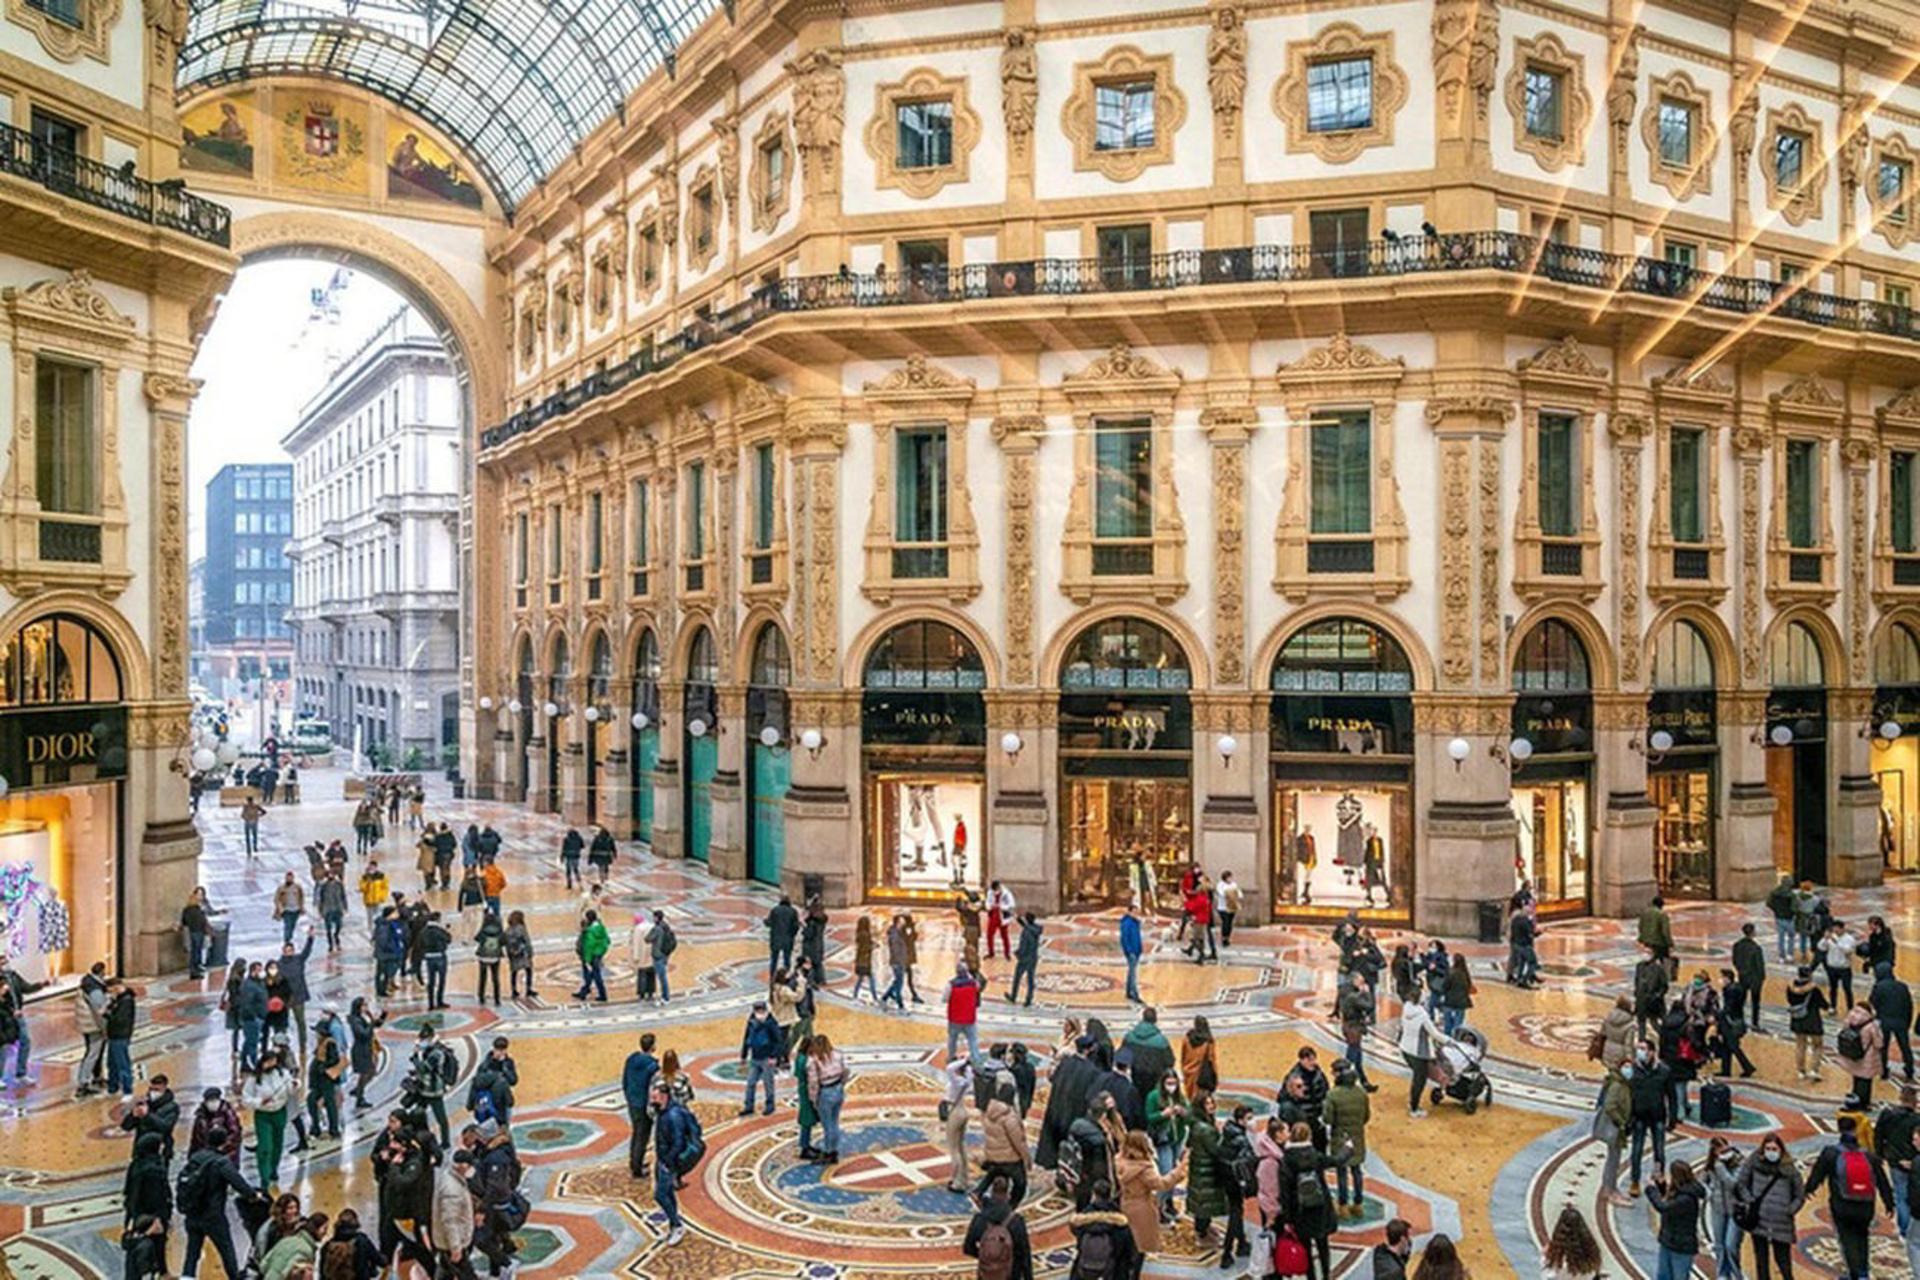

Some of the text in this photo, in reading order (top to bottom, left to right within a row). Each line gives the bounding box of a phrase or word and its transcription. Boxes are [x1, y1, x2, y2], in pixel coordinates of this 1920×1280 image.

[895, 712, 953, 725] PRADA
[1094, 715, 1155, 729] PRADA
[1308, 718, 1373, 731] PRADA
[1527, 718, 1573, 731] PRADA
[27, 732, 96, 762] DIOR
